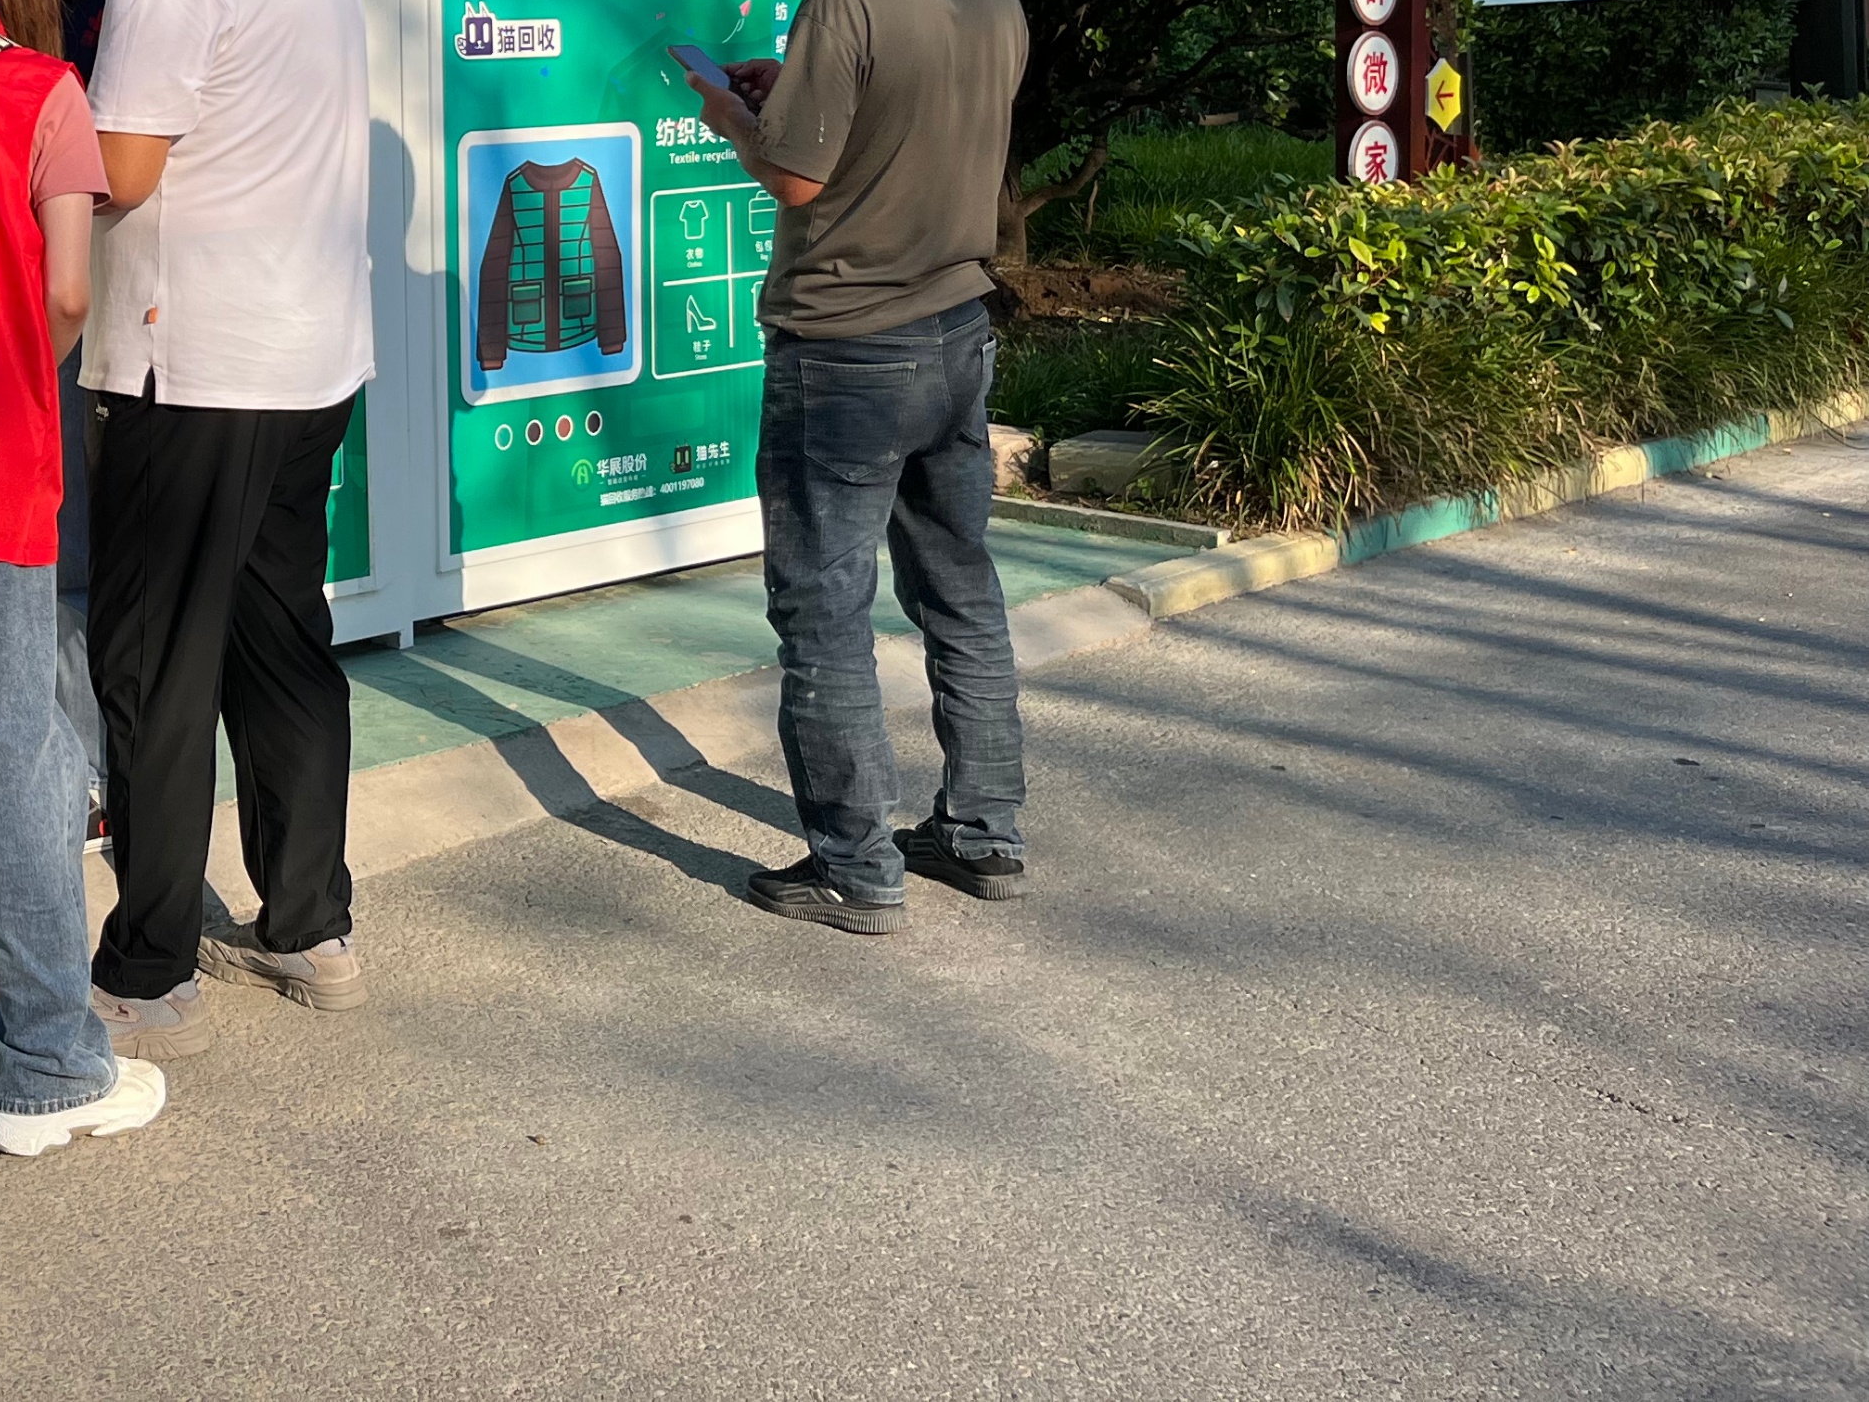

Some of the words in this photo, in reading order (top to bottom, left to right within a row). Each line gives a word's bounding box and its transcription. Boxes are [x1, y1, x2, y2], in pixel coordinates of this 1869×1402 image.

[496, 22, 556, 53] 猫回收
[655, 116, 730, 147] 纺织类
[669, 150, 701, 165] Textile
[702, 148, 739, 163] recyclin
[695, 440, 731, 462] 猫先生
[596, 452, 648, 478] 华展股份
